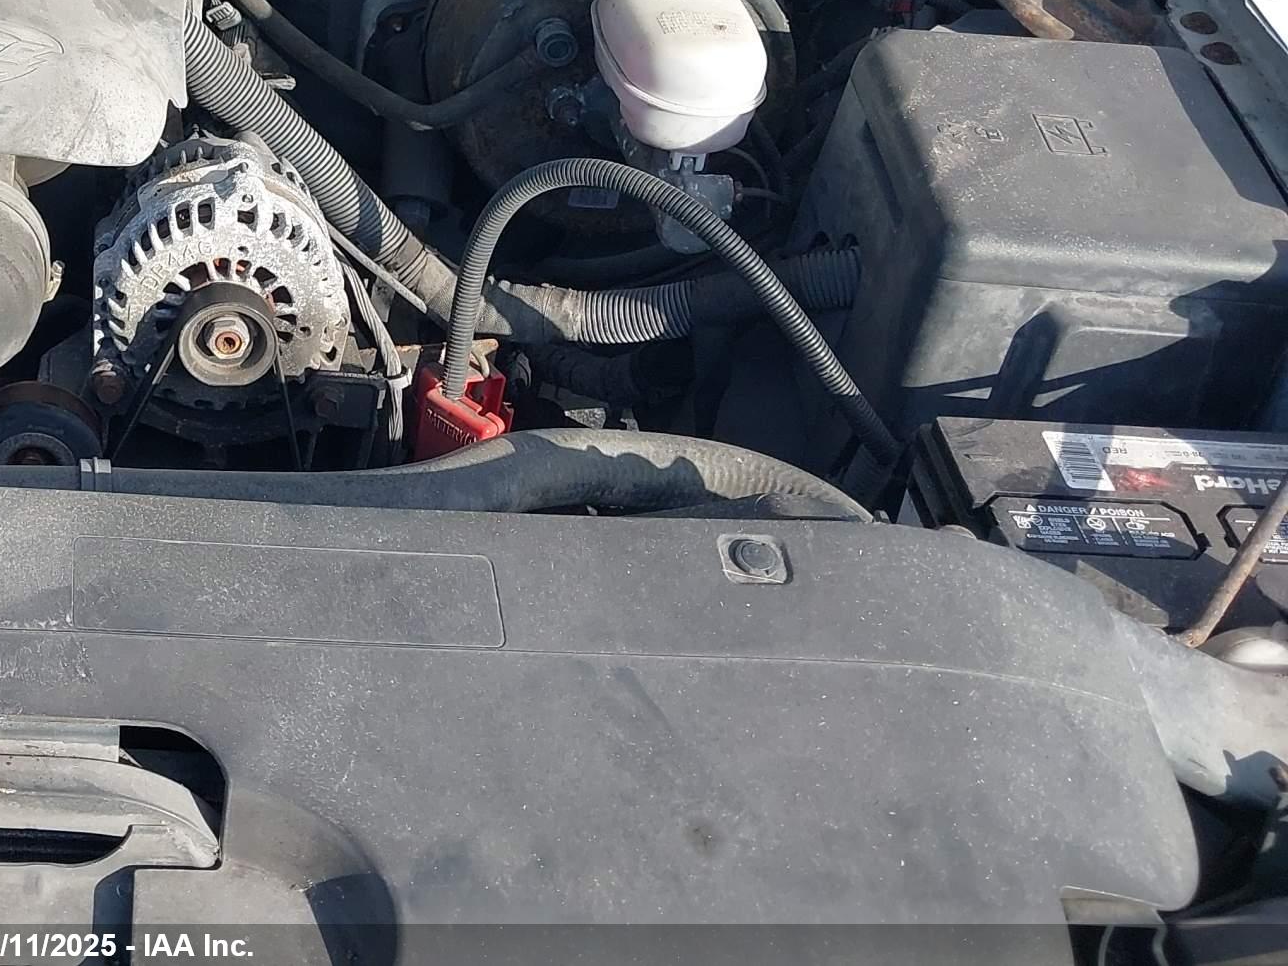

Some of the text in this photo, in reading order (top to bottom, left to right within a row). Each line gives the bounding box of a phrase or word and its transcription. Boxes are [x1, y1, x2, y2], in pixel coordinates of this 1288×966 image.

[1193, 474, 1281, 495] eHard
[1037, 505, 1088, 515] DANGER
[1098, 507, 1145, 518] POISON
